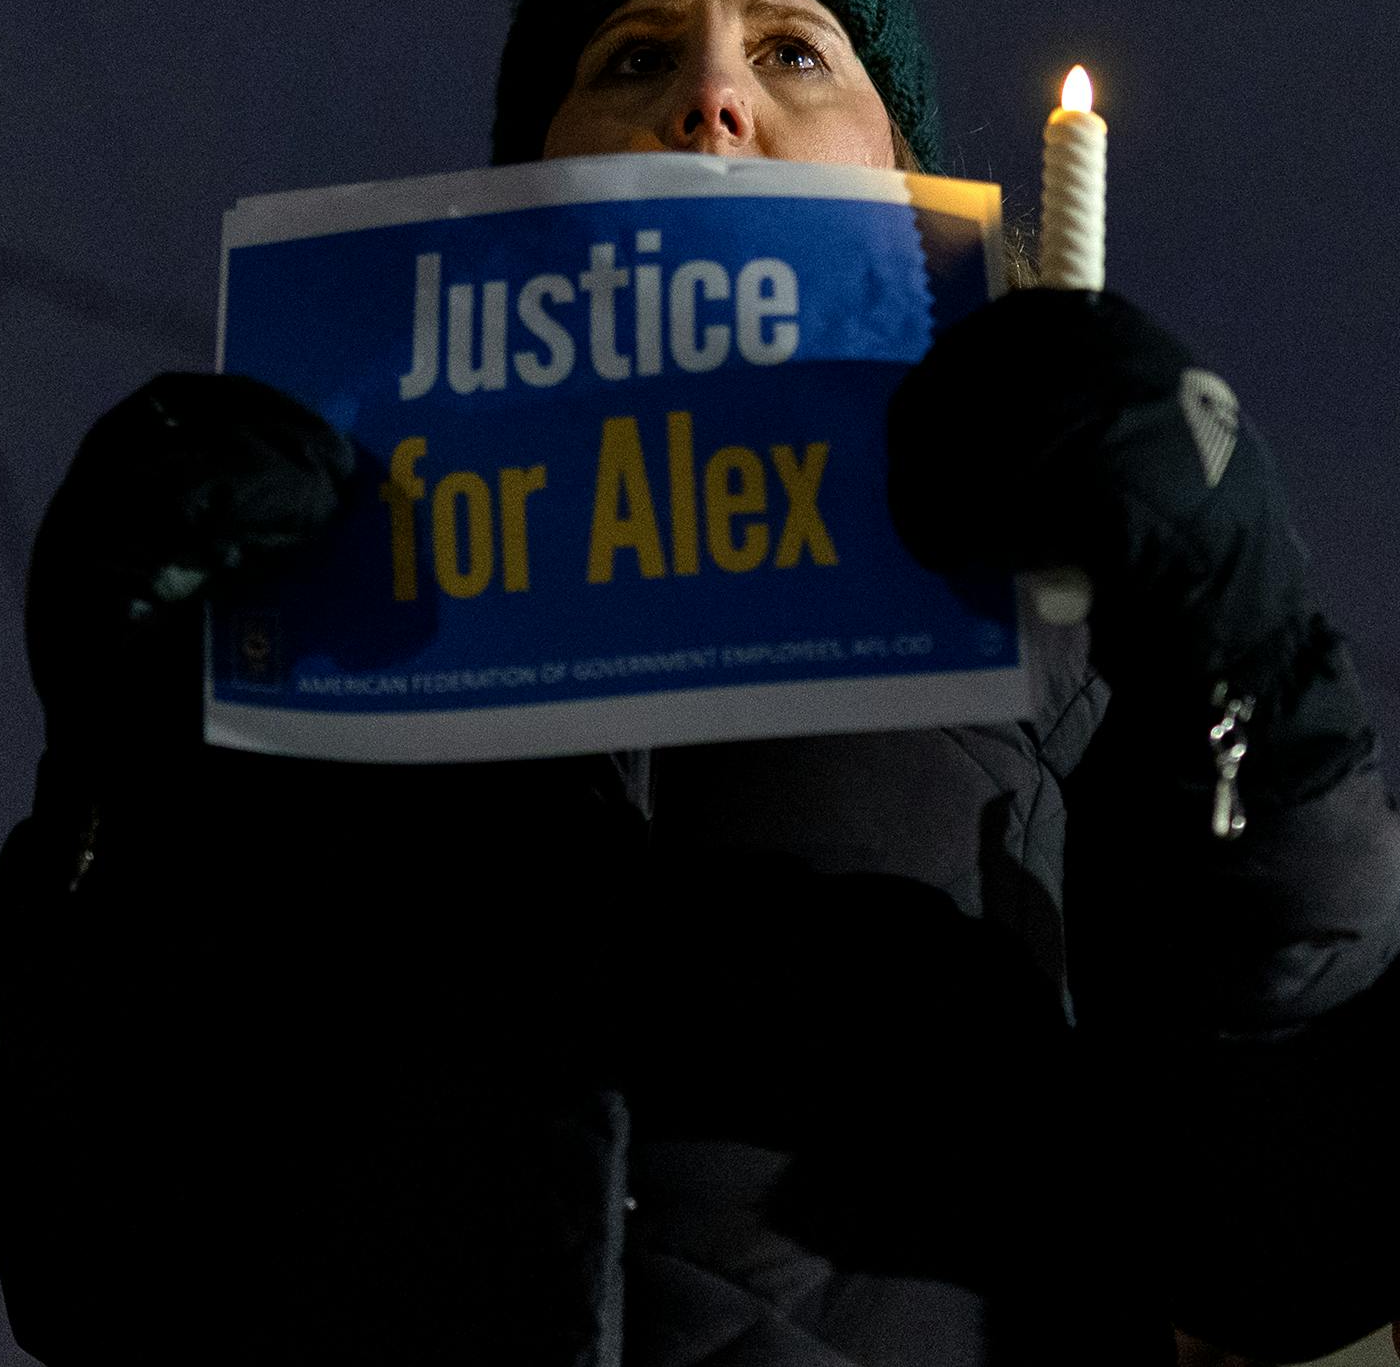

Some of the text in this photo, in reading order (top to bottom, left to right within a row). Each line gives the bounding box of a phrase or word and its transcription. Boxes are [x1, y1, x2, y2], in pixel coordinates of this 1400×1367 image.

[399, 231, 800, 401] Justice
[379, 411, 839, 602] for Alex
[297, 672, 408, 696] AMERICAN
[412, 665, 537, 694] FEDERATION
[541, 662, 566, 684] OF
[571, 647, 718, 681] GOVERNMENT
[851, 633, 934, 657] AFL-CIO
